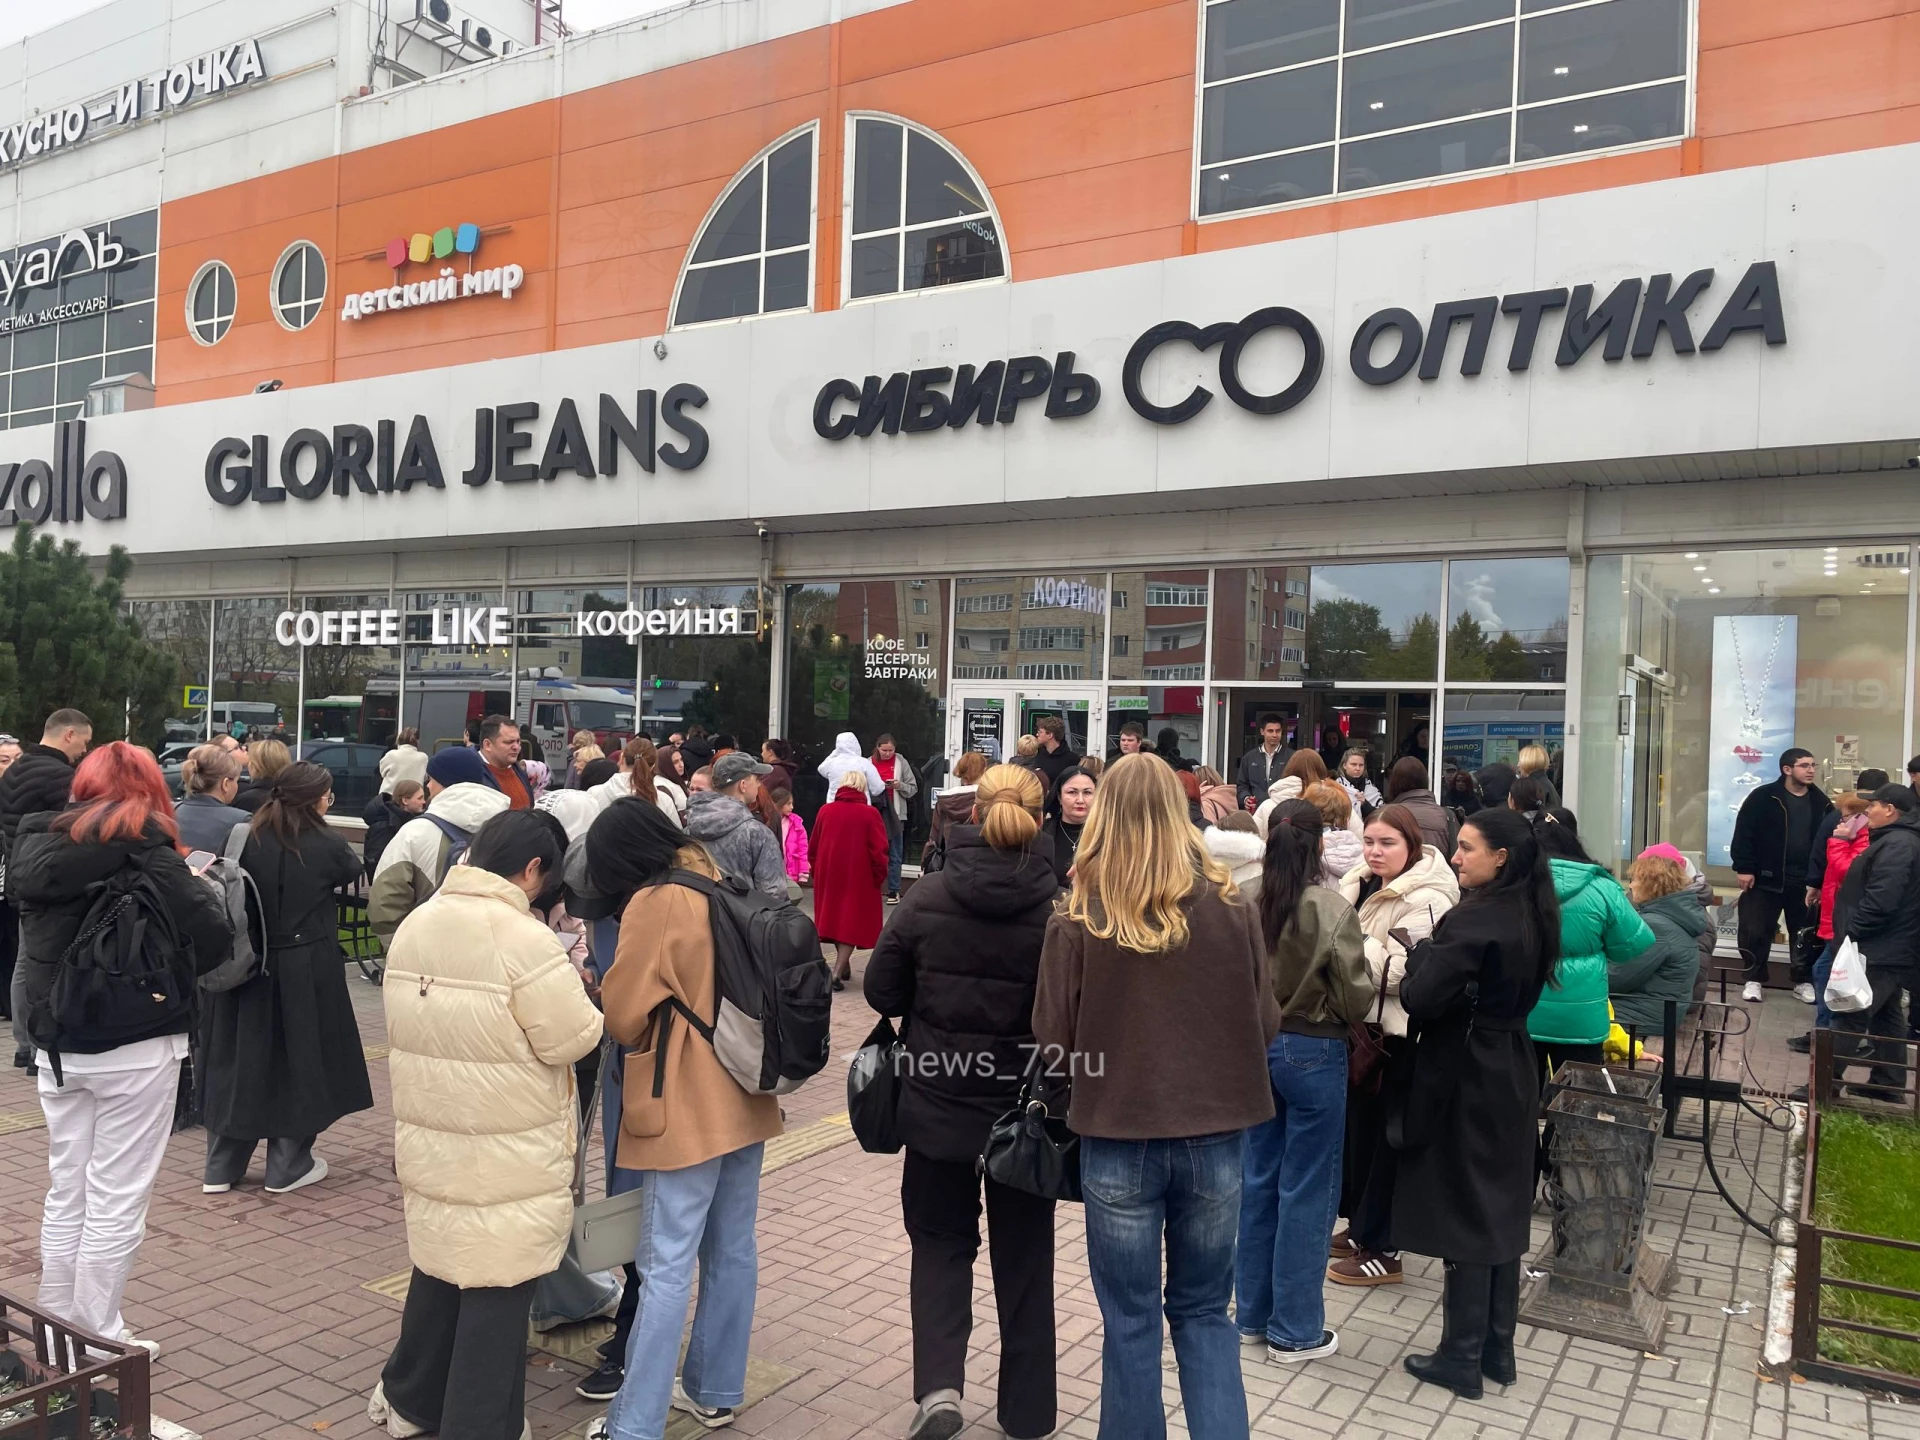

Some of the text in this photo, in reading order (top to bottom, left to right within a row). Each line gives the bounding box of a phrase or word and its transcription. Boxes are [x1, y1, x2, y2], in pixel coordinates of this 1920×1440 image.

[148, 39, 267, 112] ТОЧКА
[39, 295, 108, 323] АКСЕССУАРЫ
[341, 263, 524, 321] детский мир
[812, 351, 1101, 441] СИБИРЬ
[1349, 260, 1787, 386] ОПТИКА
[205, 383, 710, 507] GLORIA JEANS
[1034, 577, 1106, 616] КОФЕЙНЯ
[275, 606, 509, 647] COFFEE LIKE
[577, 598, 739, 645] кофейня
[864, 652, 931, 667] ДЕСЕРТЫ
[866, 638, 905, 651] КОФЕ
[864, 666, 938, 680] ЗАВТРАКИ
